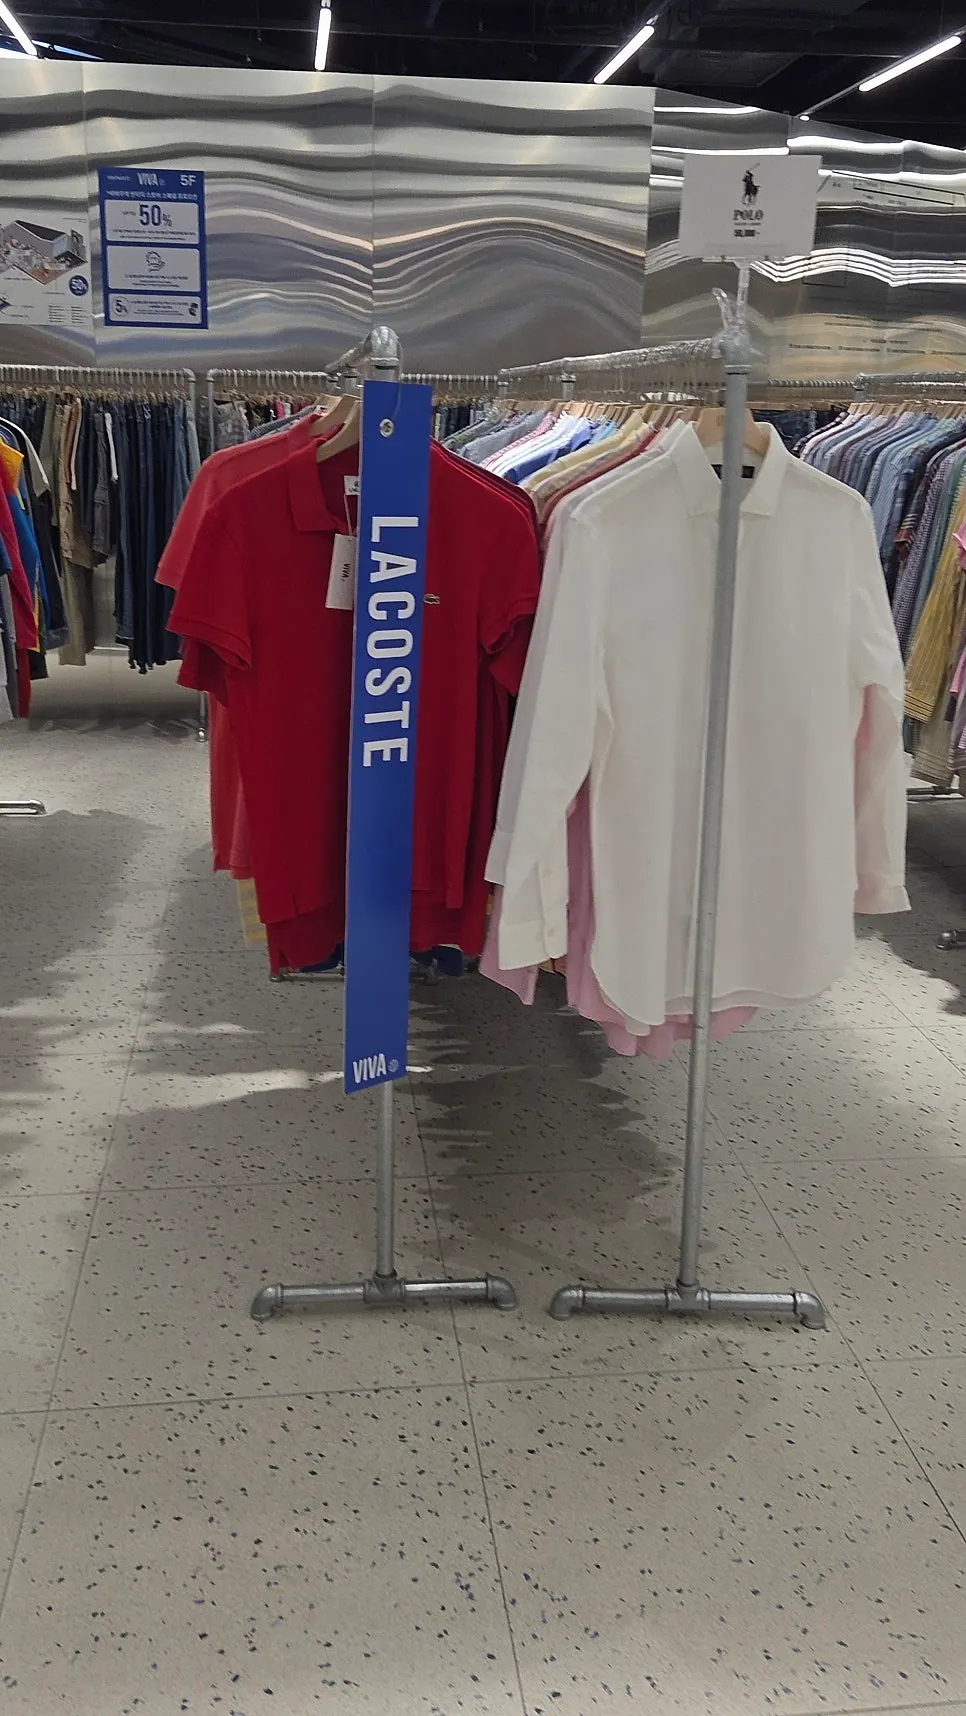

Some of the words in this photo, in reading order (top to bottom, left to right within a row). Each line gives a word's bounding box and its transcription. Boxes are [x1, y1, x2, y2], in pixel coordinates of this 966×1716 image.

[137, 172, 159, 186] VIVA
[180, 174, 197, 186] 5F
[139, 204, 173, 227] 50%
[732, 209, 764, 221] POLO
[342, 563, 351, 578] VIVA
[362, 516, 419, 767] LACOSTE
[352, 1053, 387, 1084] VIVA
